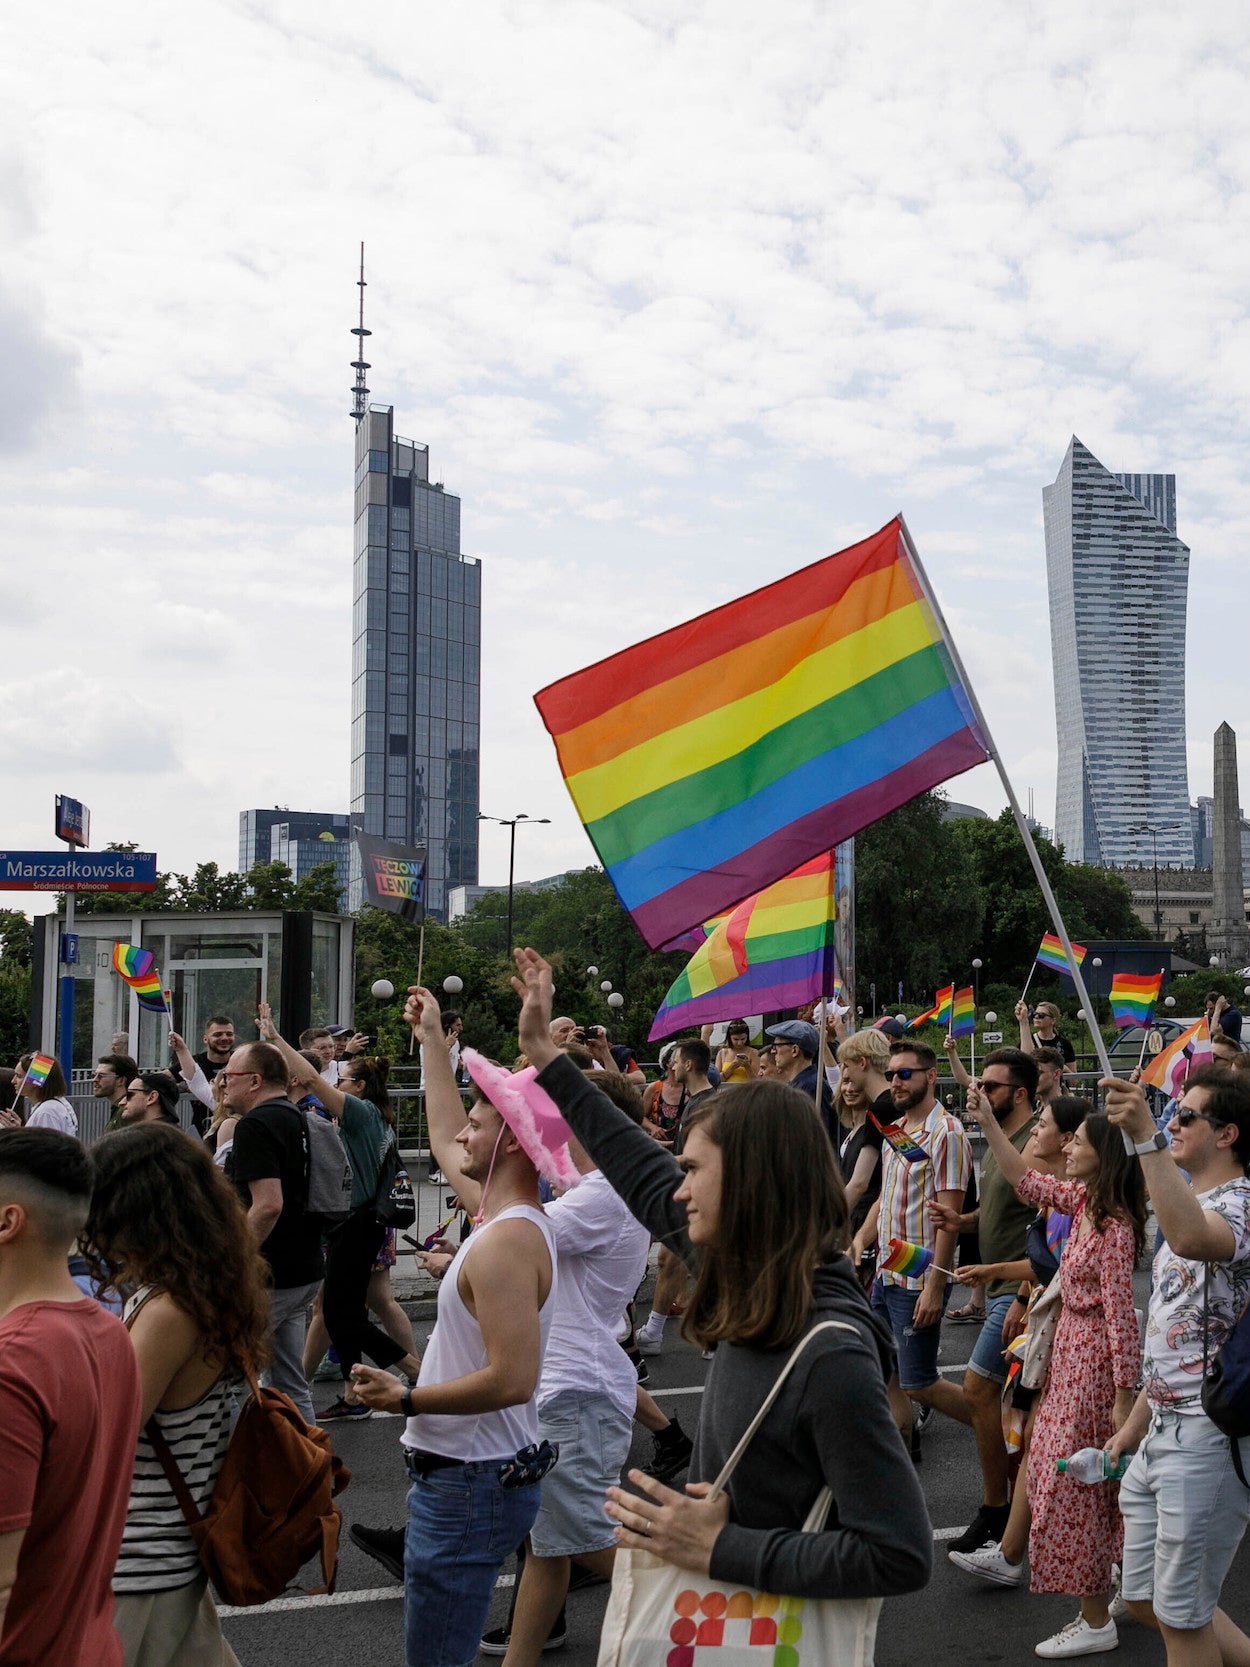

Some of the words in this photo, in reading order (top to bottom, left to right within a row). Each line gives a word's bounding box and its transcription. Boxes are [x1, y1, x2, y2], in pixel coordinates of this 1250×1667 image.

[122, 853, 152, 862] 105-107
[6, 860, 135, 878] Marszałkowska
[33, 880, 74, 890] Śródmieście
[77, 882, 110, 891] Północne
